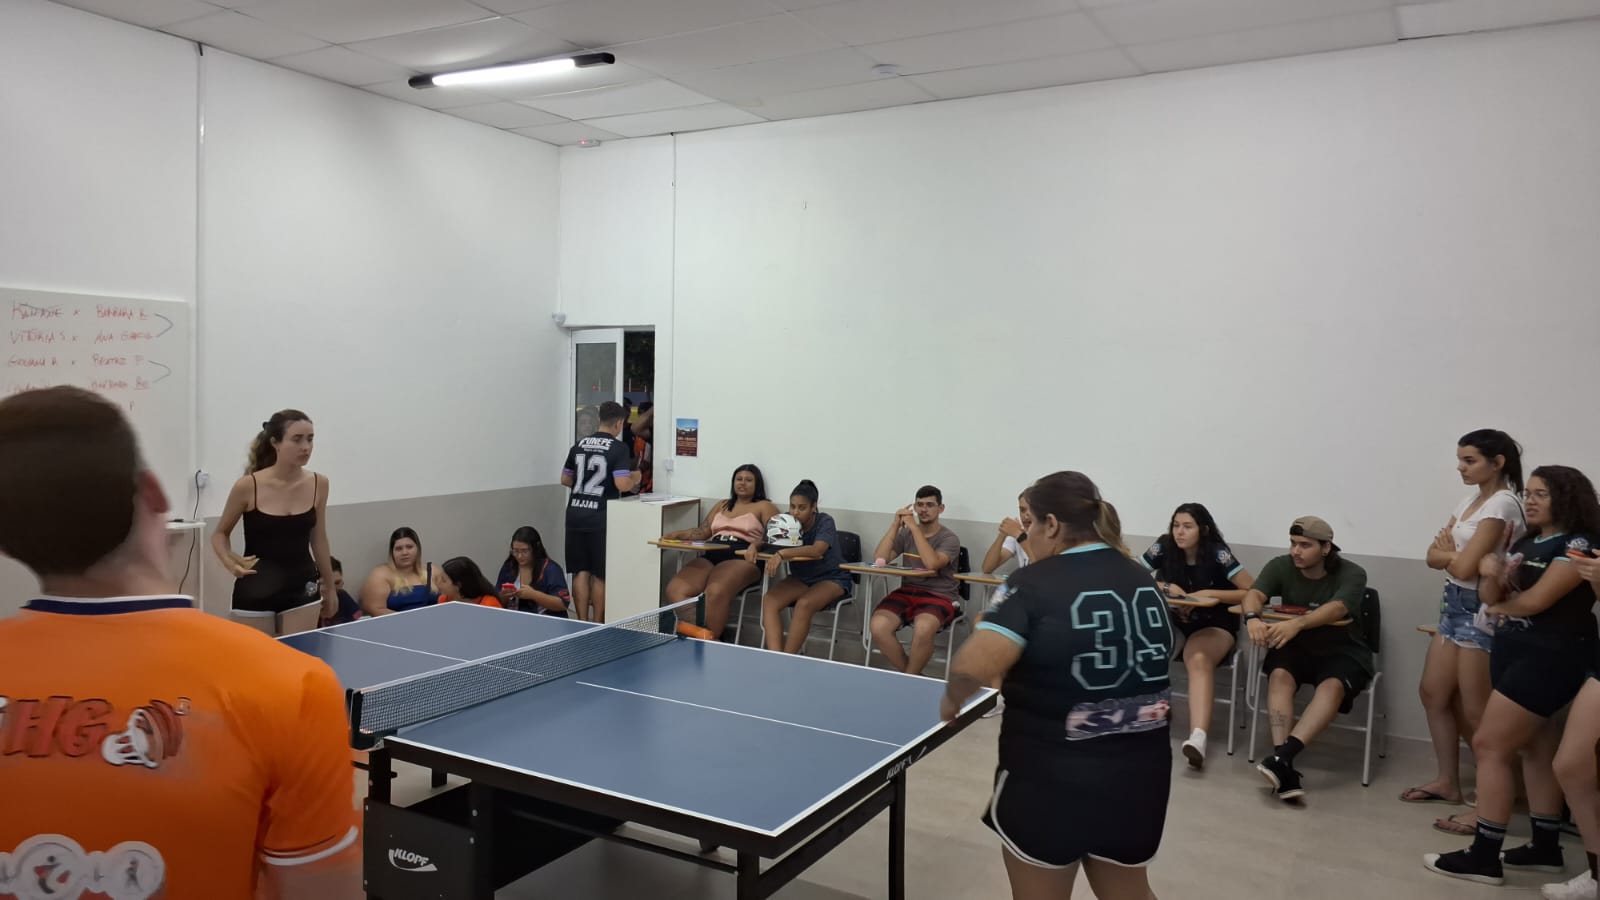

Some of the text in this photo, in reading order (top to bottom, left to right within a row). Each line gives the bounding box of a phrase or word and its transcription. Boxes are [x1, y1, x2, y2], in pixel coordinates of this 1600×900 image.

[573, 453, 608, 497] 12
[1071, 586, 1174, 690] 39
[394, 848, 429, 866] KLOPF
